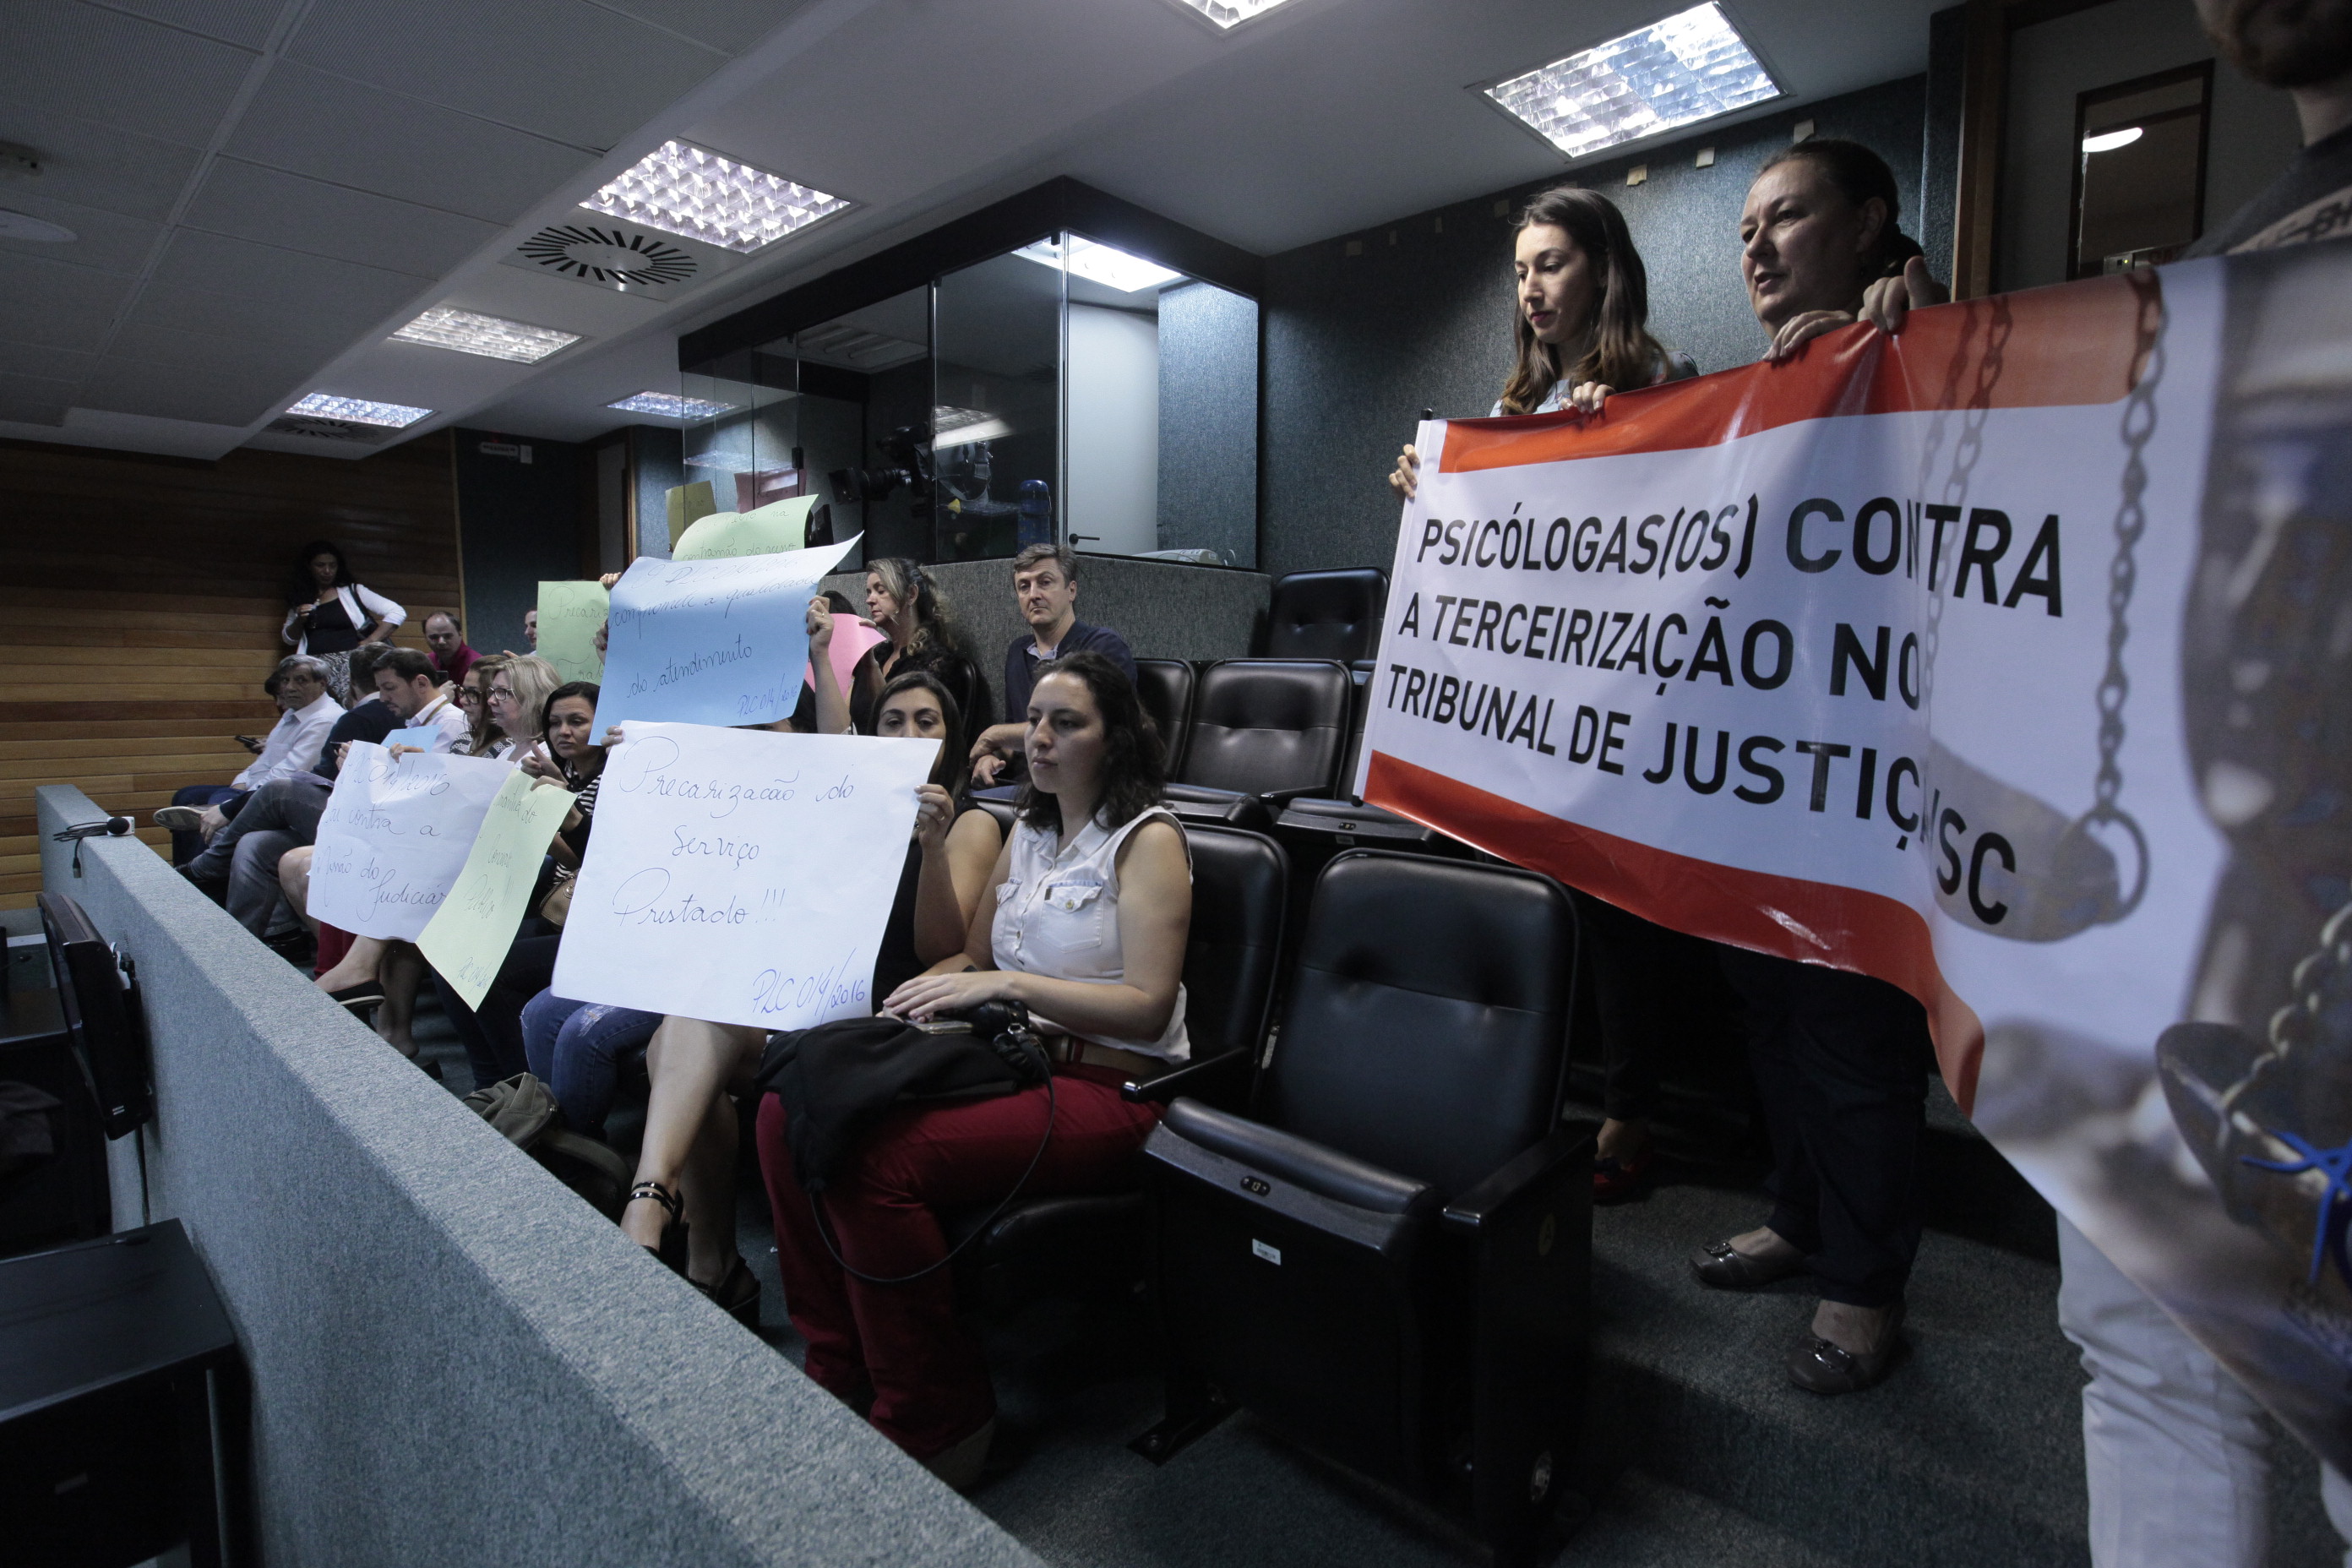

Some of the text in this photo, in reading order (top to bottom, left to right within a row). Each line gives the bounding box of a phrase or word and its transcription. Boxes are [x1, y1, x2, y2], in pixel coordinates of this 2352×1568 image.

[1416, 493, 2063, 618] PSICÓLOGAS(OS) CONTRA
[626, 633, 752, 699] do atendimento
[1397, 592, 1920, 711] A TERCEIRIZAÇÃO NO
[1386, 664, 1556, 757] TRIBUNAL
[1568, 705, 1632, 776] DE
[815, 774, 854, 802] do
[348, 803, 406, 836] contra
[419, 825, 441, 837] a
[356, 868, 448, 923] Judiciár
[360, 857, 380, 879] do
[753, 968, 795, 1014] PLC
